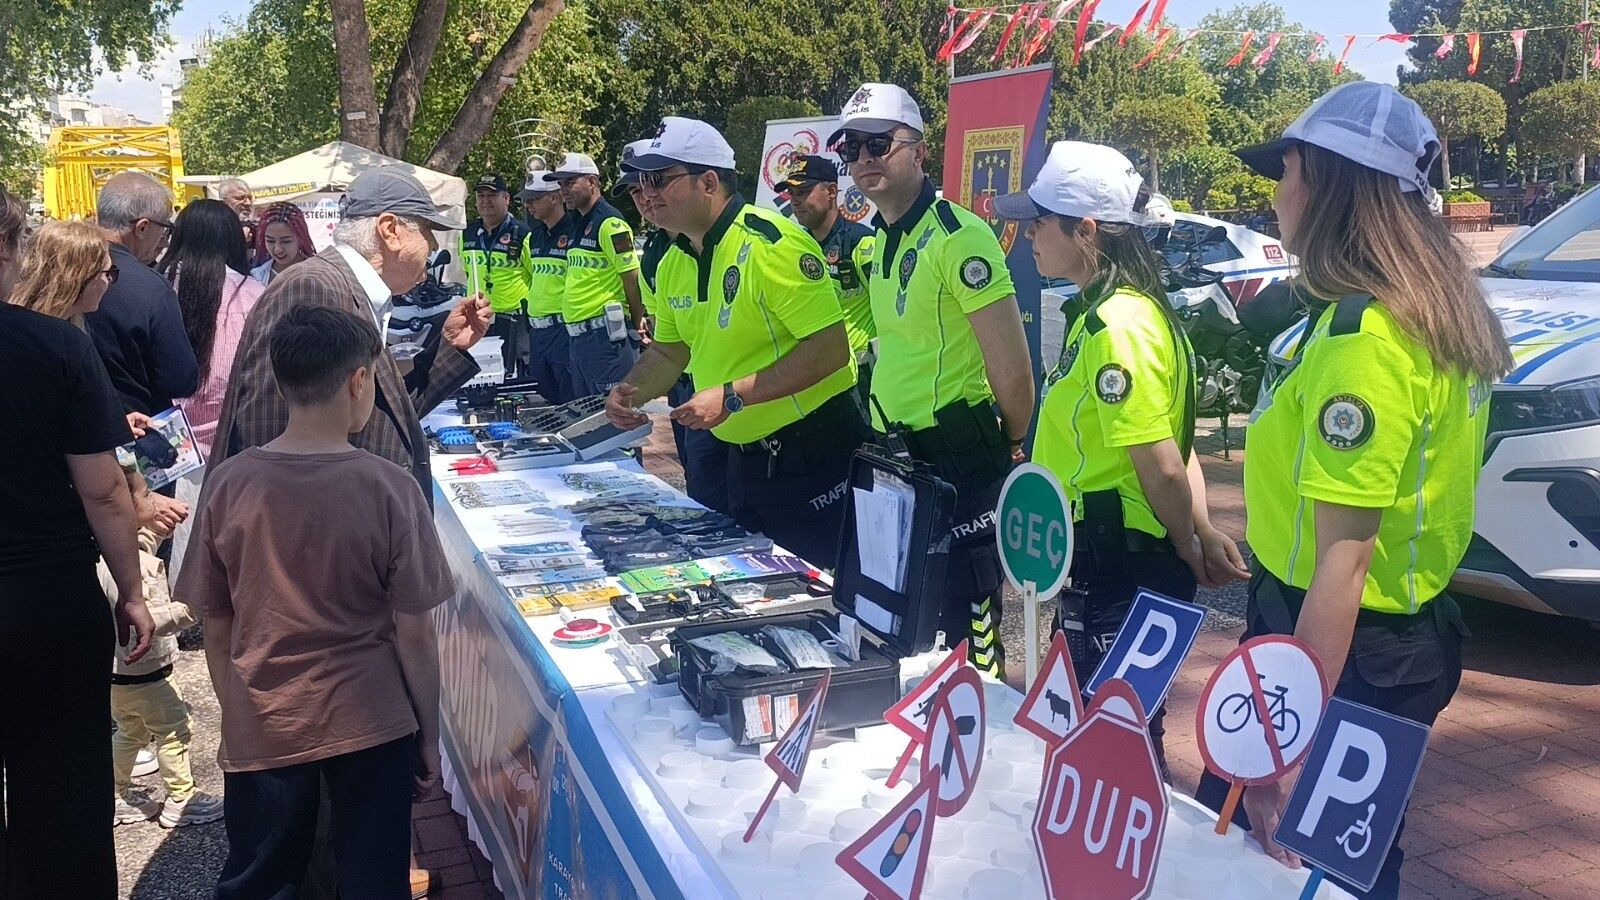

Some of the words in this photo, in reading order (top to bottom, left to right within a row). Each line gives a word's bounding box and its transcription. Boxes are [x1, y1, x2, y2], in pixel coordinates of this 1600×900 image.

[1265, 246, 1281, 259] 112
[668, 295, 692, 309] POLİS
[1006, 507, 1064, 569] GEÇ
[1112, 609, 1177, 679] P
[1296, 719, 1387, 838] P
[1046, 763, 1153, 879] DUR
